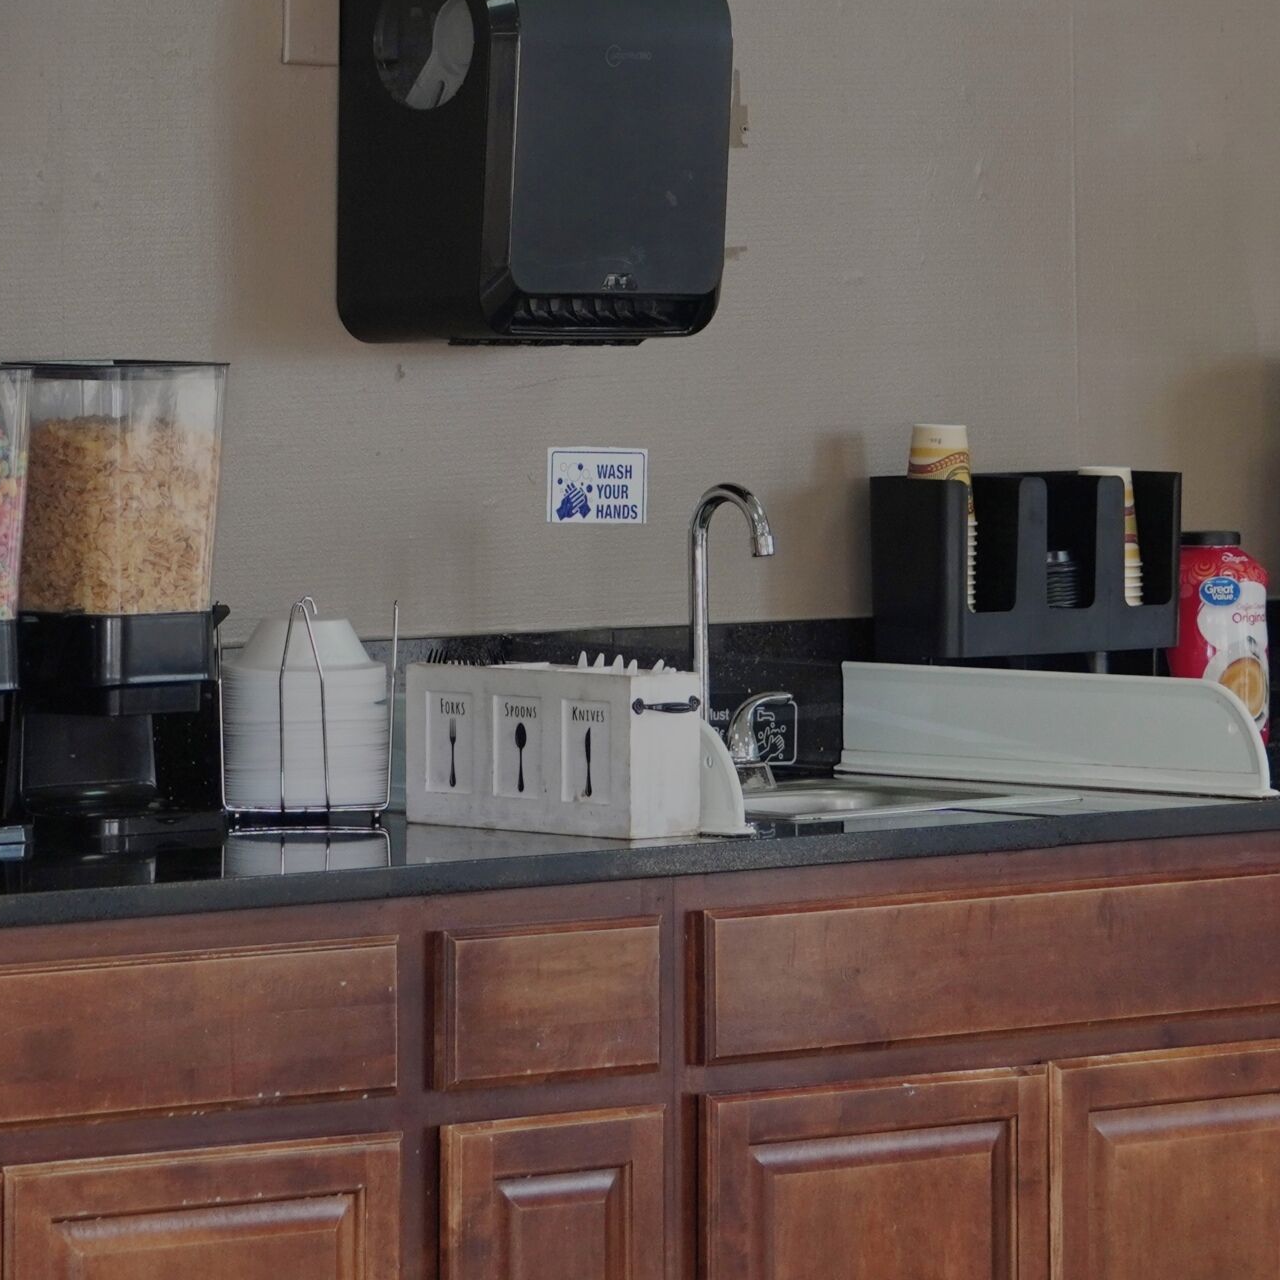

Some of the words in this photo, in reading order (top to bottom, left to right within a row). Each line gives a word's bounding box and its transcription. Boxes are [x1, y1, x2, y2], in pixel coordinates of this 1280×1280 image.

[596, 464, 632, 480] WASH
[597, 484, 629, 500] YOUR
[596, 504, 638, 520] HANDS
[1204, 583, 1234, 595] Great
[1211, 592, 1234, 601] Value
[440, 698, 466, 716] FORKS
[504, 702, 537, 718] SPOONS
[572, 706, 605, 723] KNIVES
